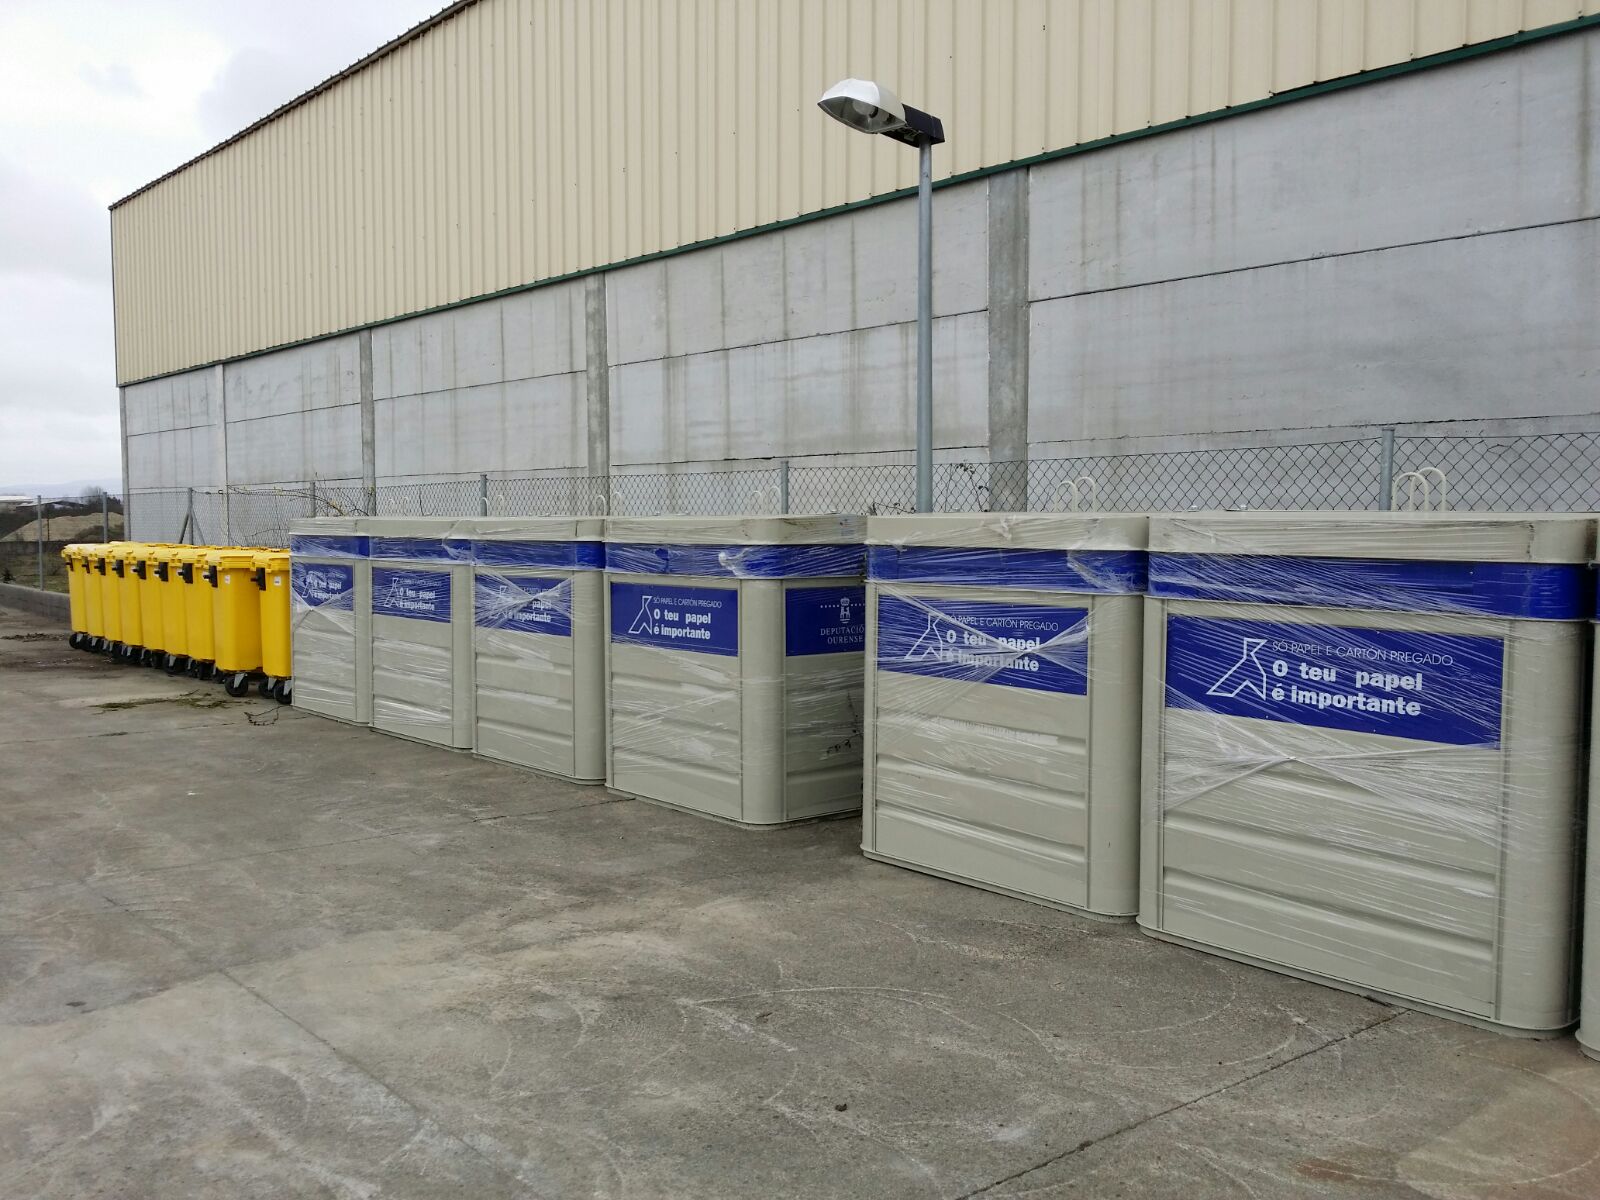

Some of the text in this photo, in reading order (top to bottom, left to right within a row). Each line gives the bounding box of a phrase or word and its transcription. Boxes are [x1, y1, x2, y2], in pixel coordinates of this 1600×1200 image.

[660, 597, 673, 605] PAPEL
[674, 598, 678, 606] E
[678, 597, 698, 607] CARTÓN
[698, 599, 723, 609] PREGADO
[664, 609, 679, 622] teu
[685, 612, 712, 626] papel
[979, 617, 985, 626] E
[986, 616, 1018, 629] CARTÓN
[1019, 619, 1059, 632] PREGADO
[653, 622, 711, 640] é importante
[820, 624, 865, 636] DEPUTACIÓ
[827, 635, 864, 645] OURENSE
[963, 631, 987, 646] teu
[1272, 640, 1454, 666] SÓ PAPEL E CARTÓN PREGADO
[1299, 662, 1337, 682] teu
[1355, 670, 1423, 693] papel
[1271, 682, 1421, 717] é importante
